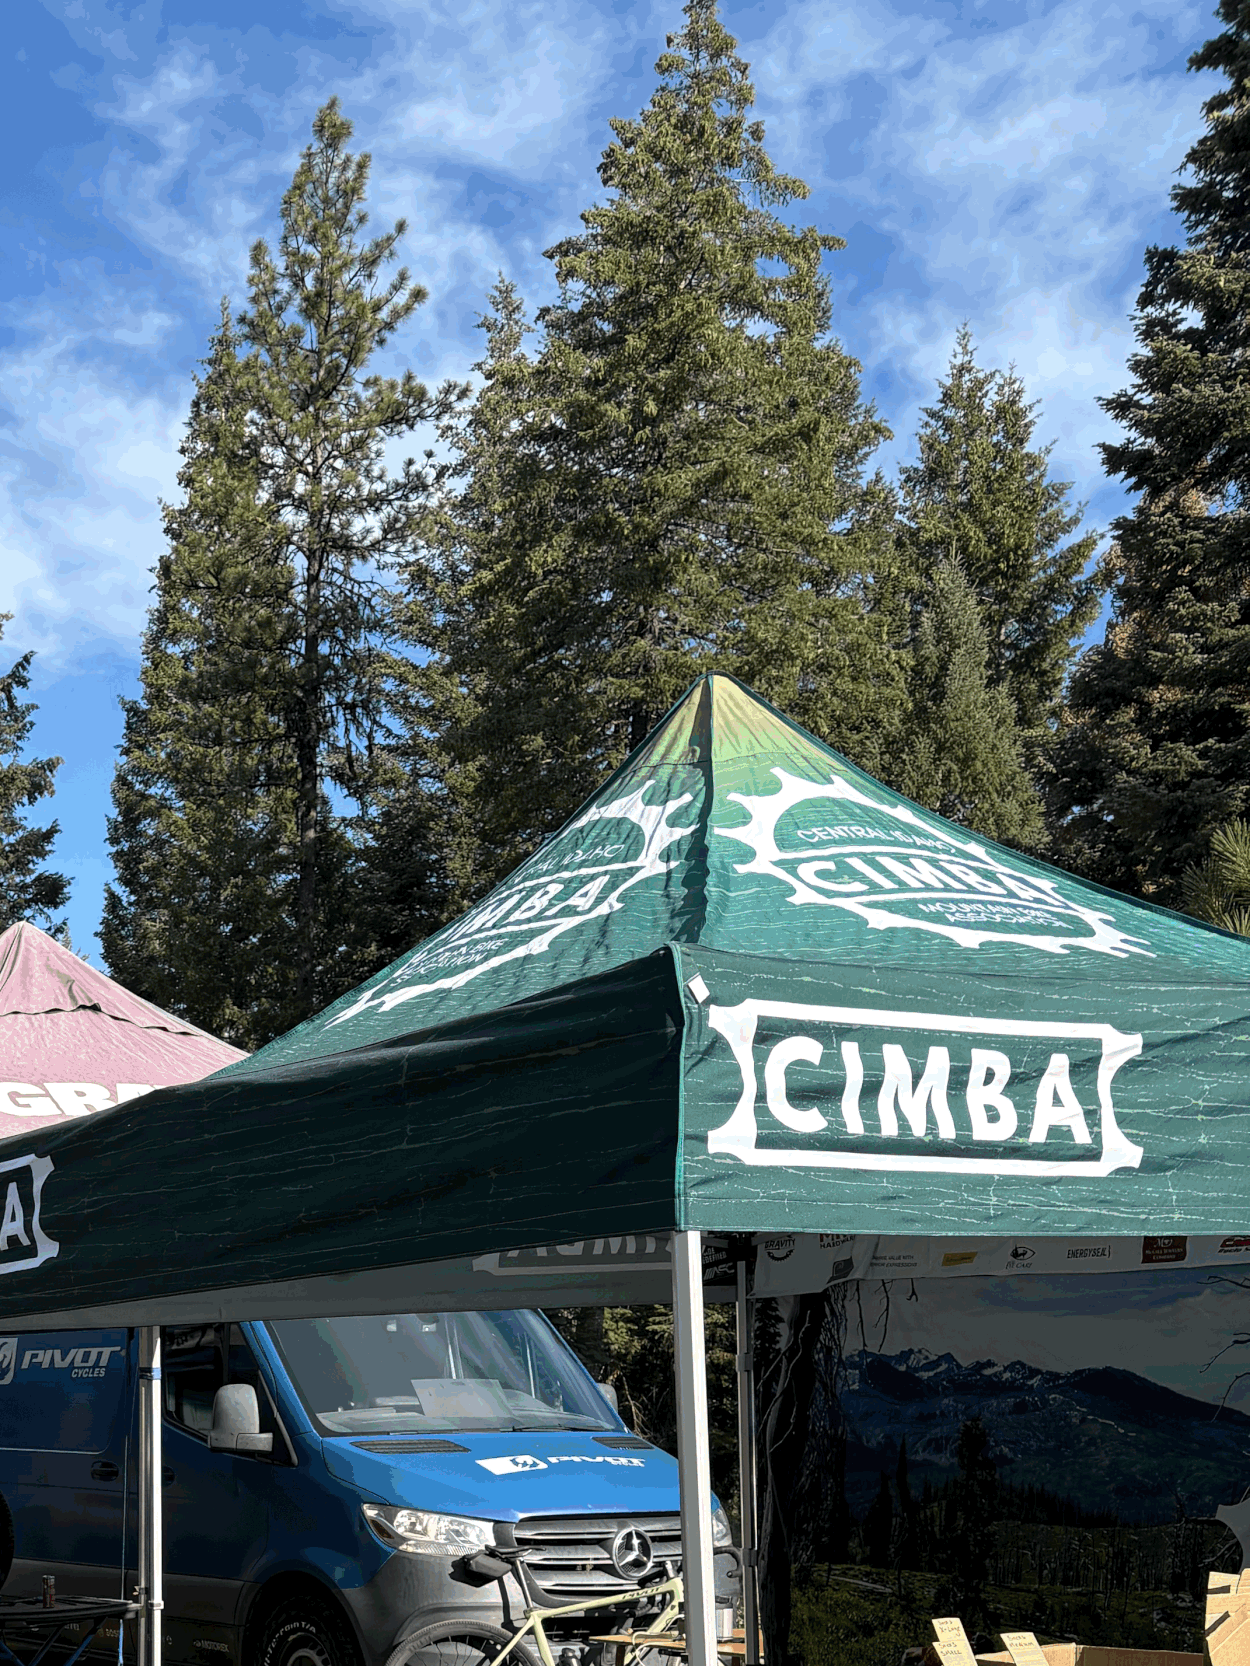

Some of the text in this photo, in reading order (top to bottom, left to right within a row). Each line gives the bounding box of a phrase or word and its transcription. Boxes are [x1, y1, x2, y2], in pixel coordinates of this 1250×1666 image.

[796, 824, 956, 854] CENTRAL IDAHO
[796, 856, 1065, 907] CIMBA
[764, 1036, 1093, 1144] CIMBA
[764, 1238, 796, 1250] GRAVITY
[20, 1345, 123, 1370] PIVOT
[71, 1367, 106, 1378] CYCLES
